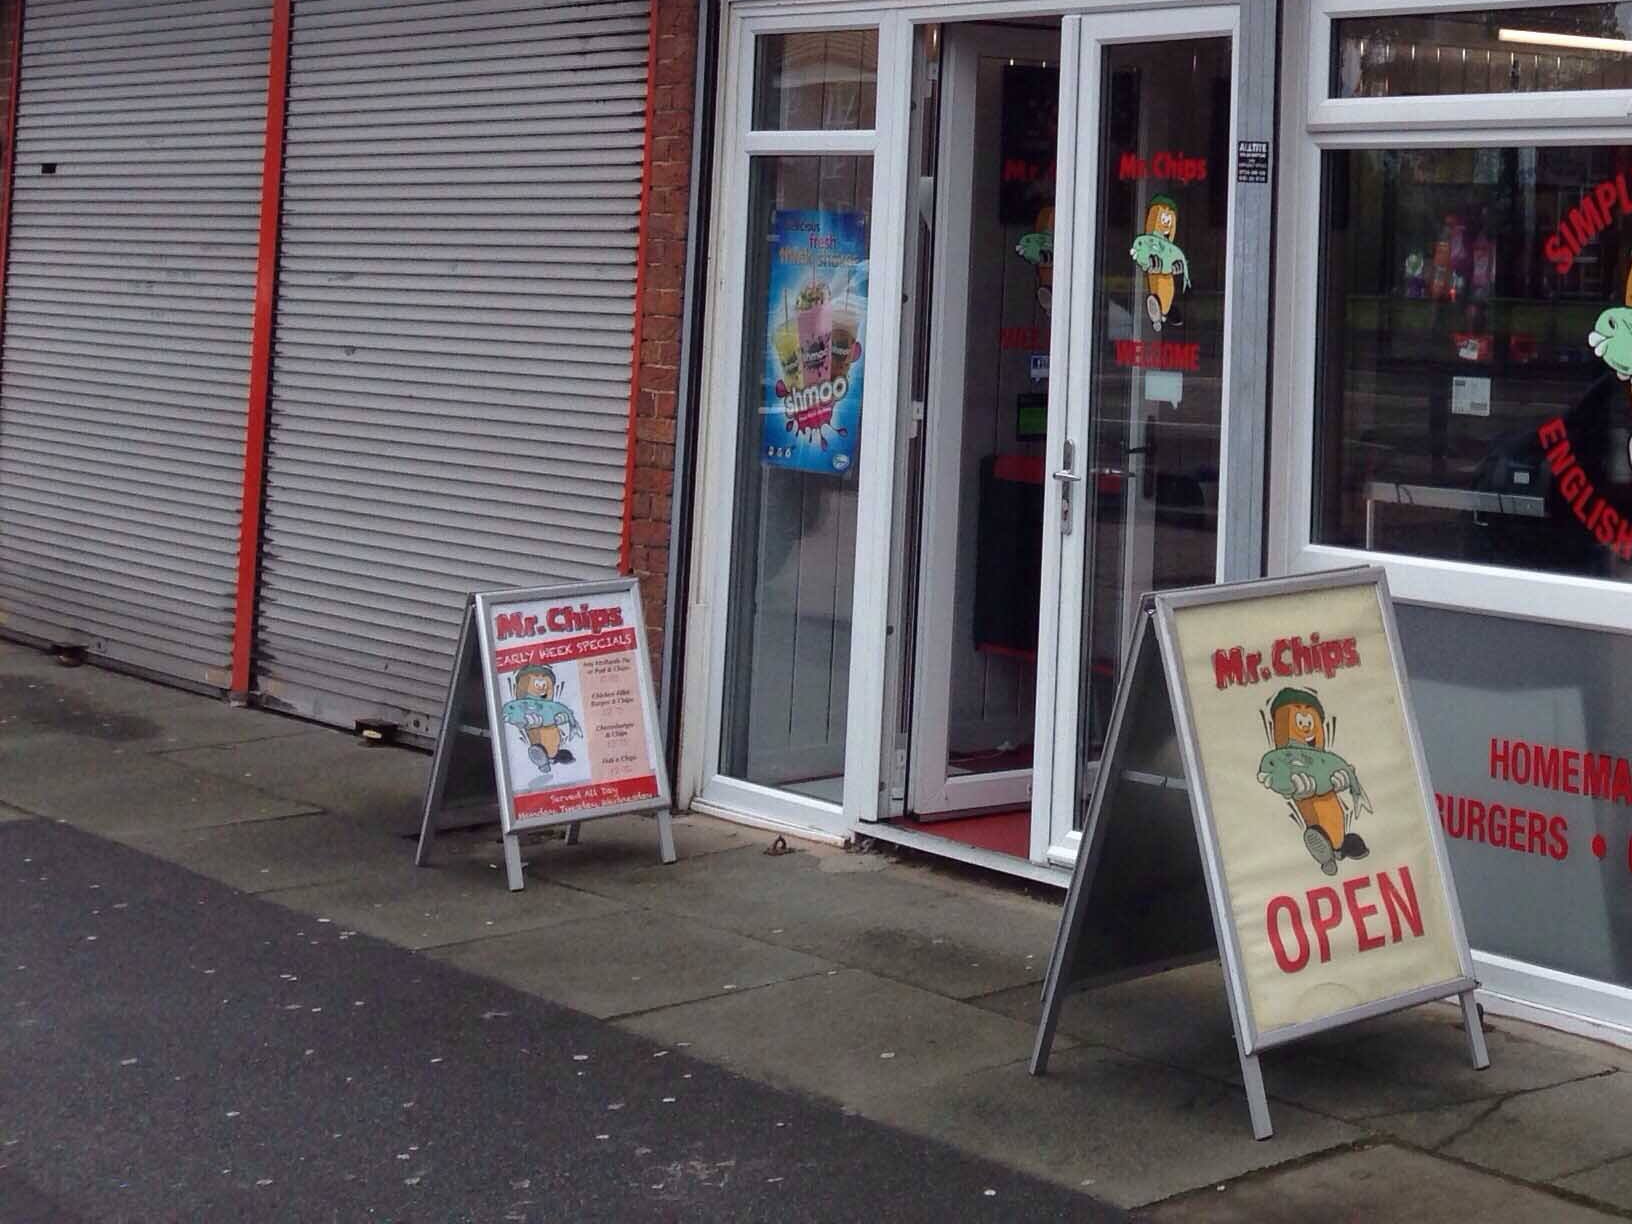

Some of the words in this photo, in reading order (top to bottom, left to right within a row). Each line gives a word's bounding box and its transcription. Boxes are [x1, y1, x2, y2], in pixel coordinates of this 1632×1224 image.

[784, 377, 848, 418] shmoo
[539, 644, 573, 659] WEEK
[576, 634, 632, 653] SPECIALS
[1265, 865, 1425, 973] OPEN
